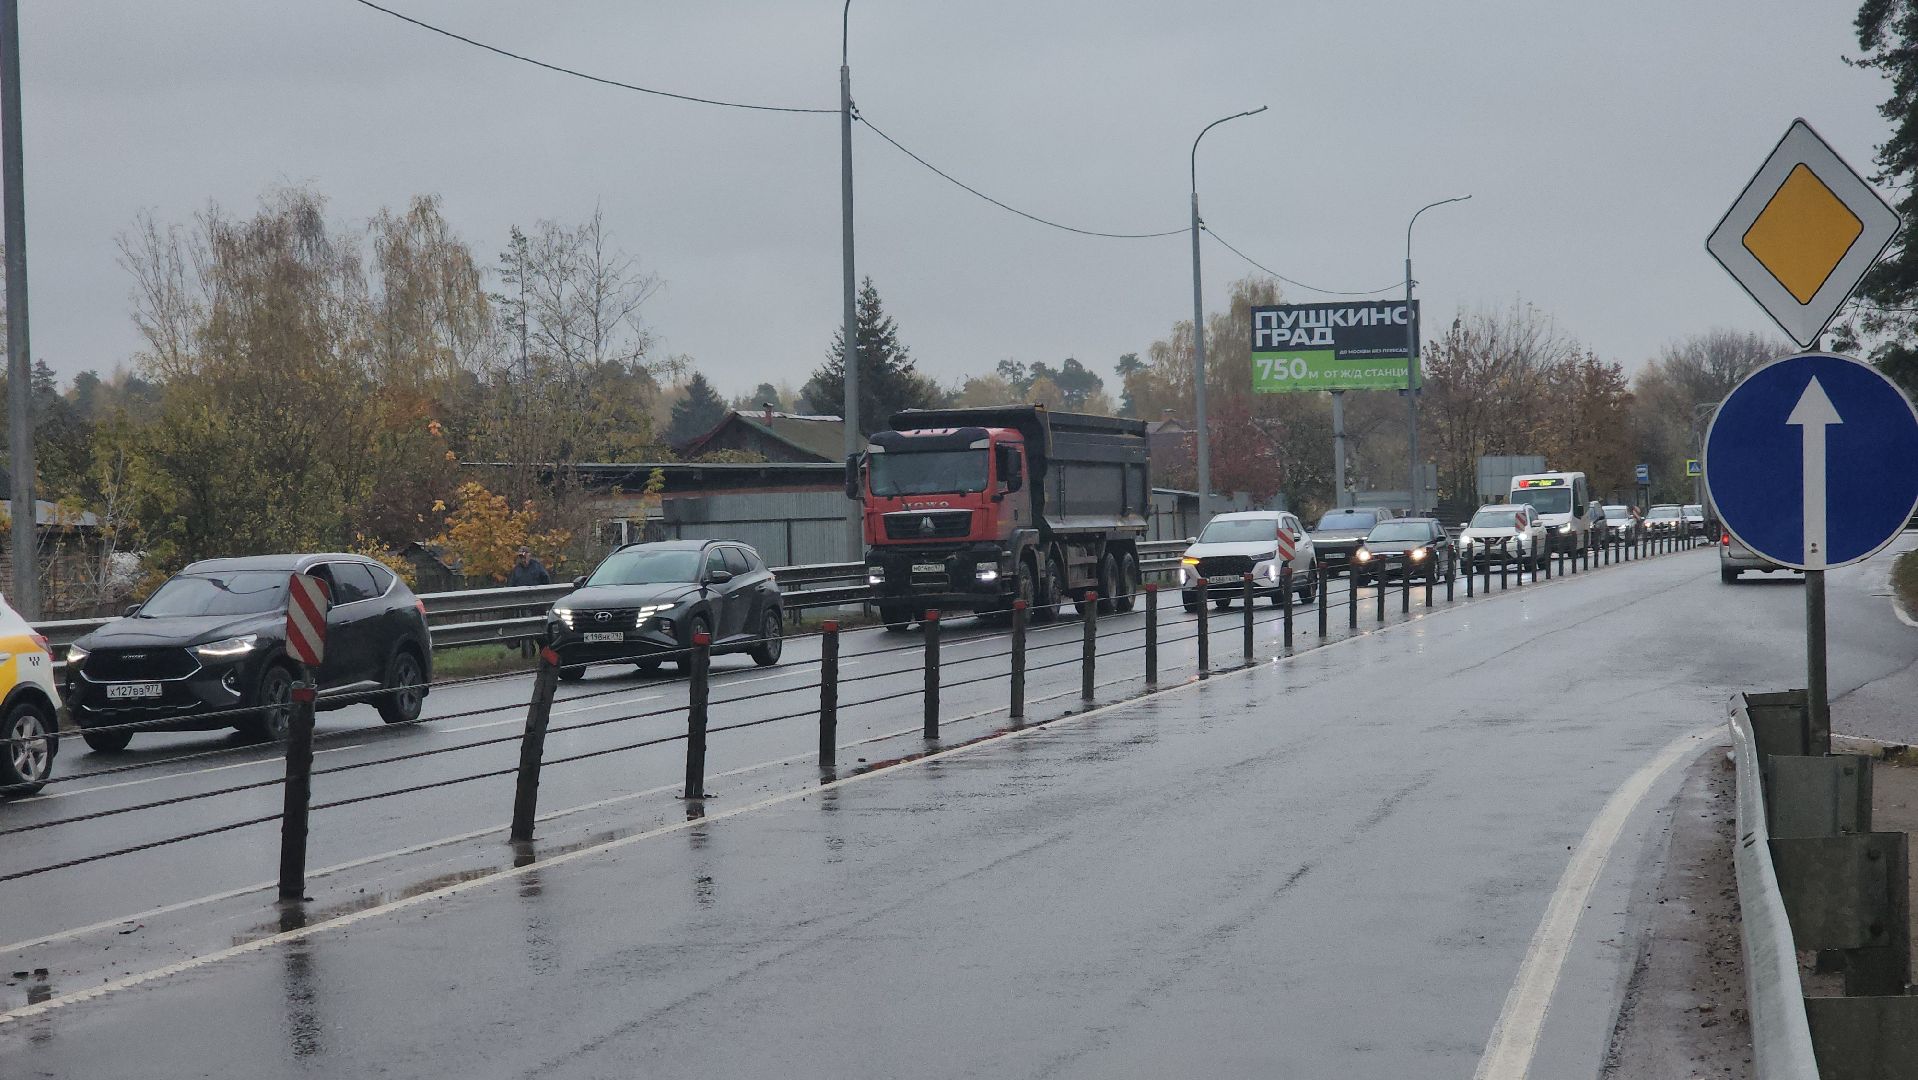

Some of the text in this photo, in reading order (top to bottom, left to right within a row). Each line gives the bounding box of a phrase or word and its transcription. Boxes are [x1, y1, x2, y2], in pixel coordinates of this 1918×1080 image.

[1255, 307, 1415, 329] ПУШКИНО
[1255, 328, 1335, 347] ГРАД
[1364, 367, 1408, 378] СТАНЦИ
